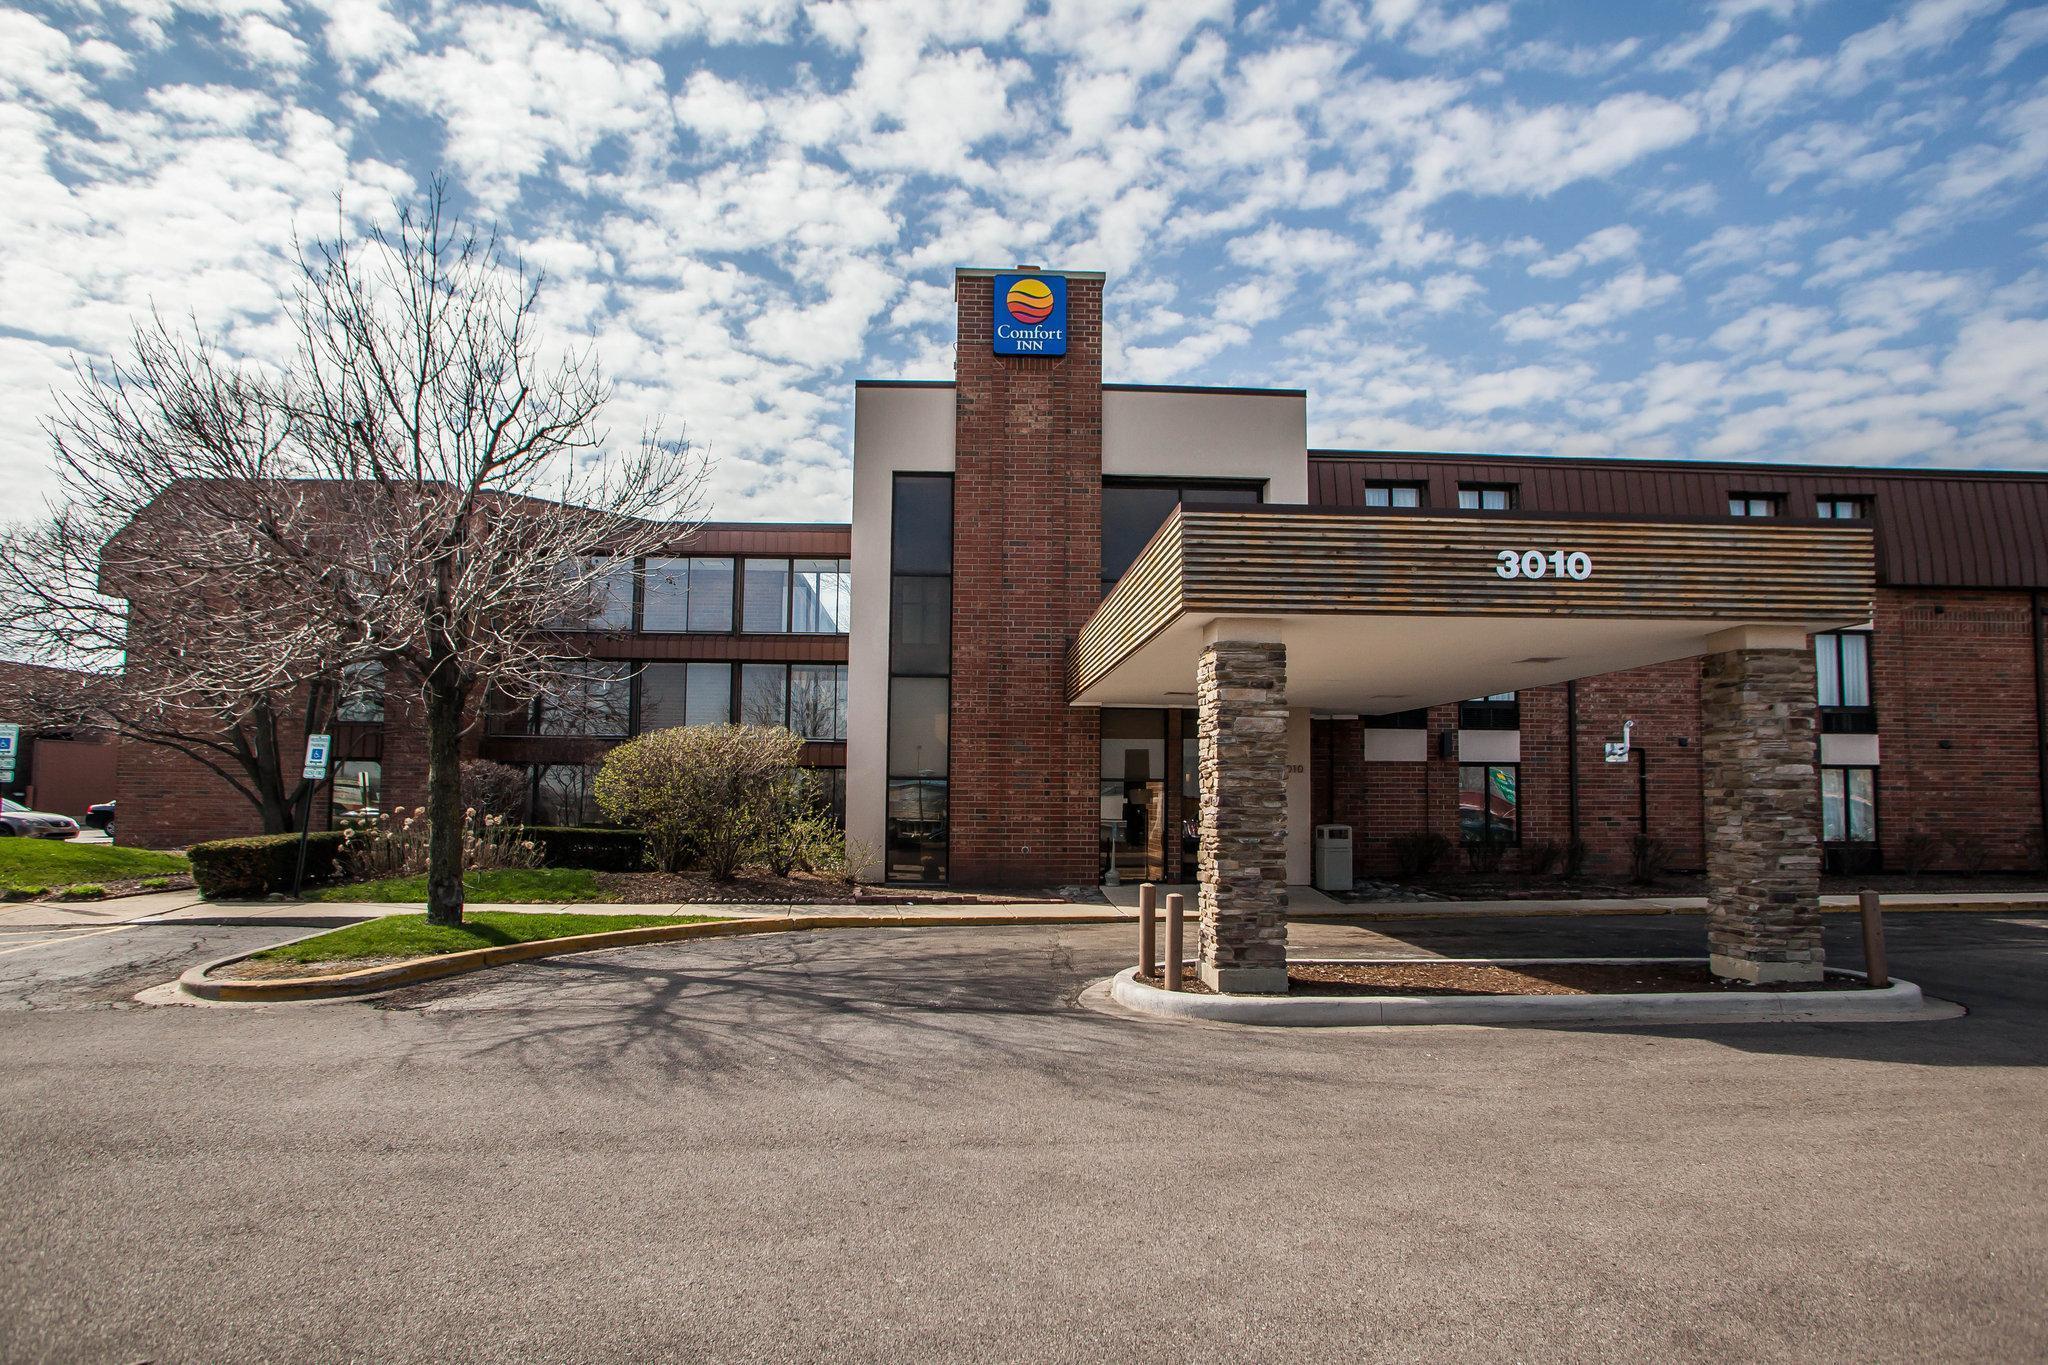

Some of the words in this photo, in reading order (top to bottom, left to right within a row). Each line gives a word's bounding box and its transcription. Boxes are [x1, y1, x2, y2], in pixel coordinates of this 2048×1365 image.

[997, 324, 1063, 340] Comfort
[1016, 340, 1043, 351] INN
[1496, 550, 1592, 580] 3010
